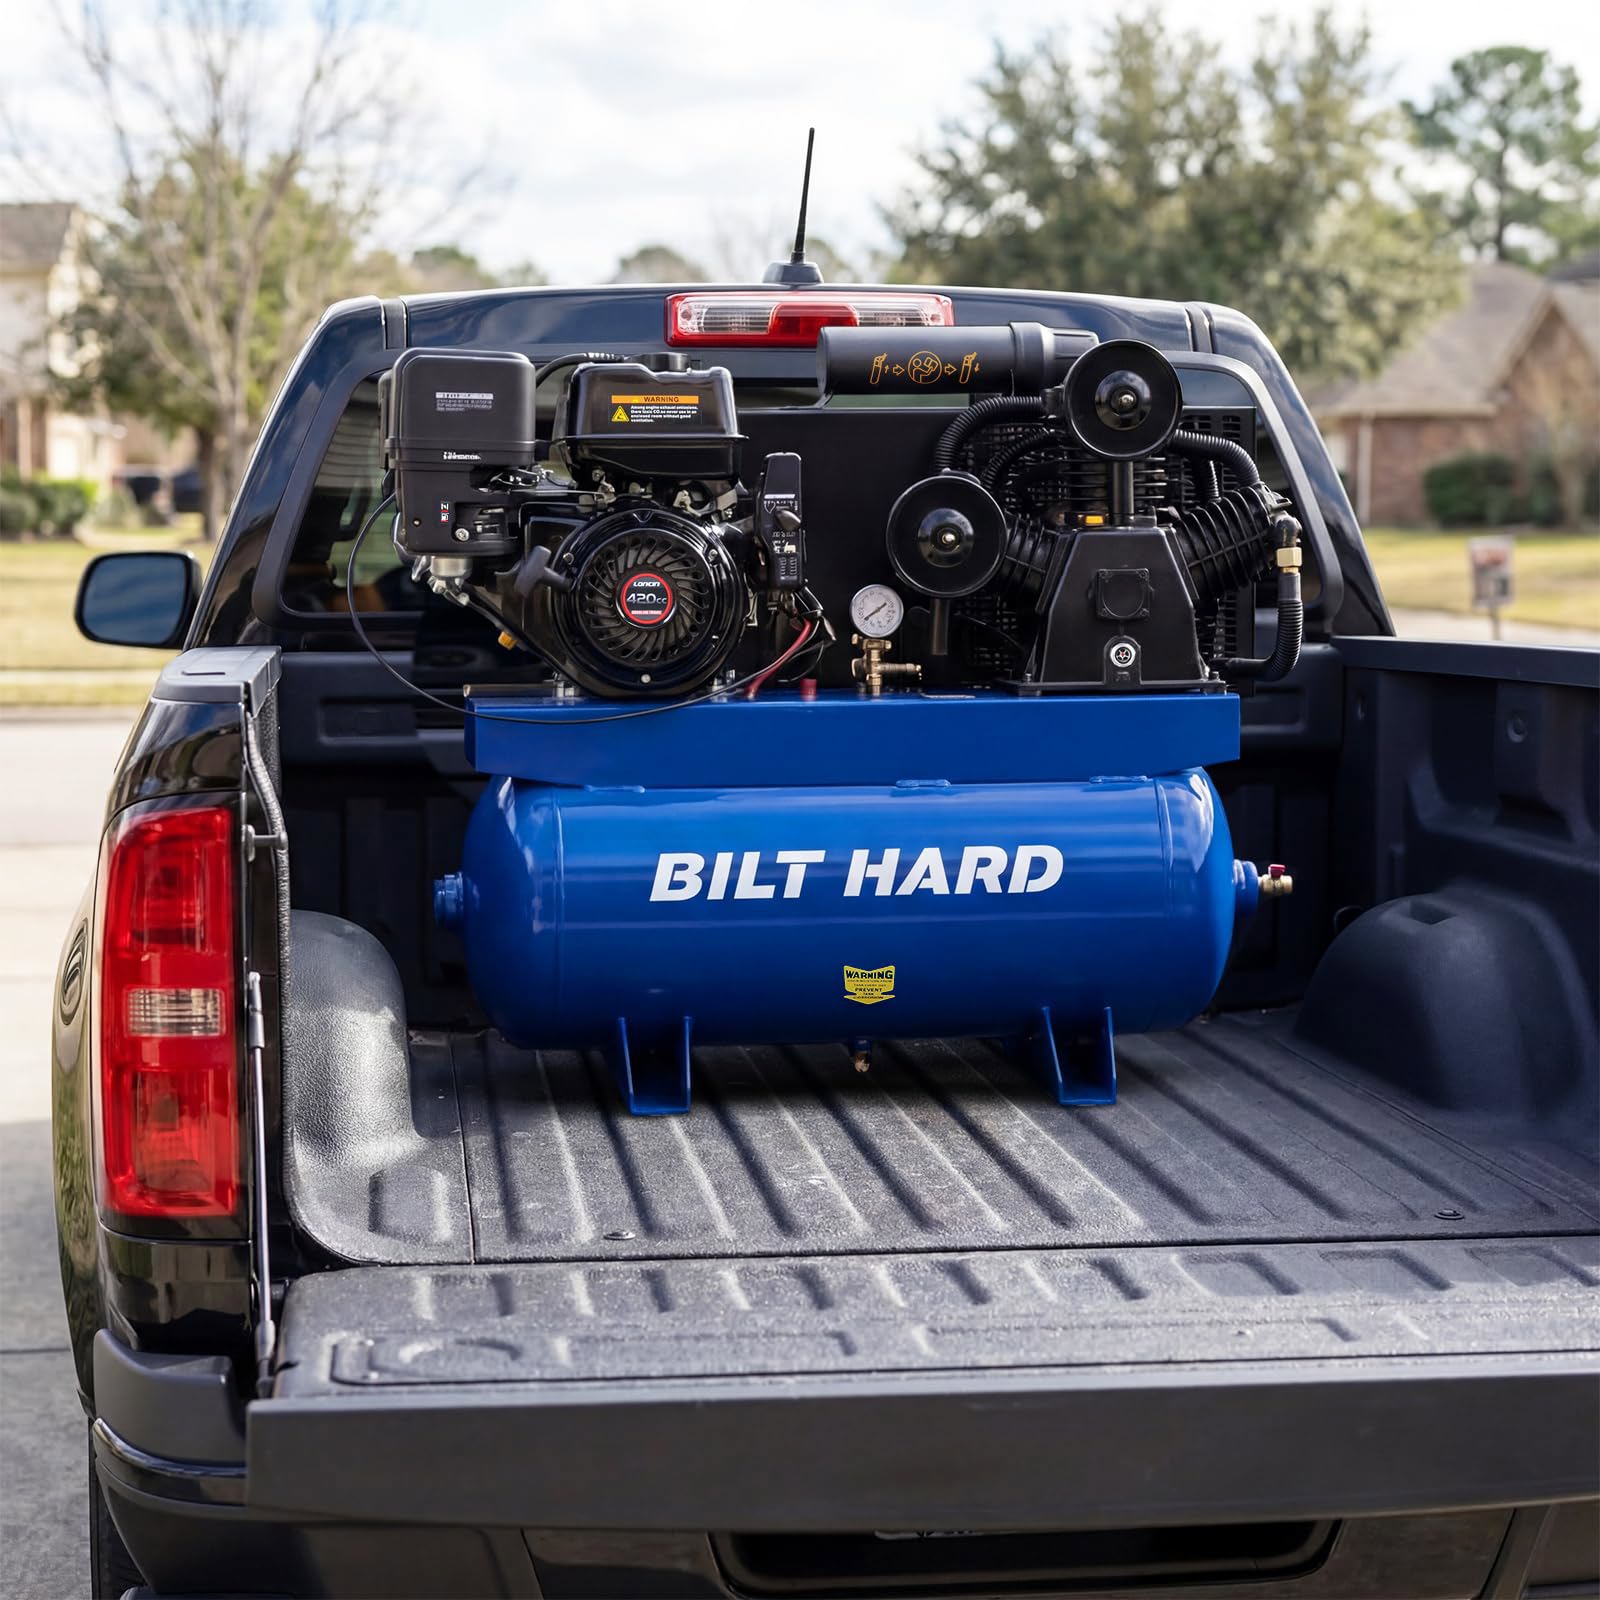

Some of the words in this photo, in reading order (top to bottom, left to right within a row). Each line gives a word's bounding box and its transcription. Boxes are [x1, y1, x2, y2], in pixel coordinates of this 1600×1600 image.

[649, 849, 826, 903] BILT
[842, 844, 1064, 898] HARD
[846, 970, 893, 979] WARNING
